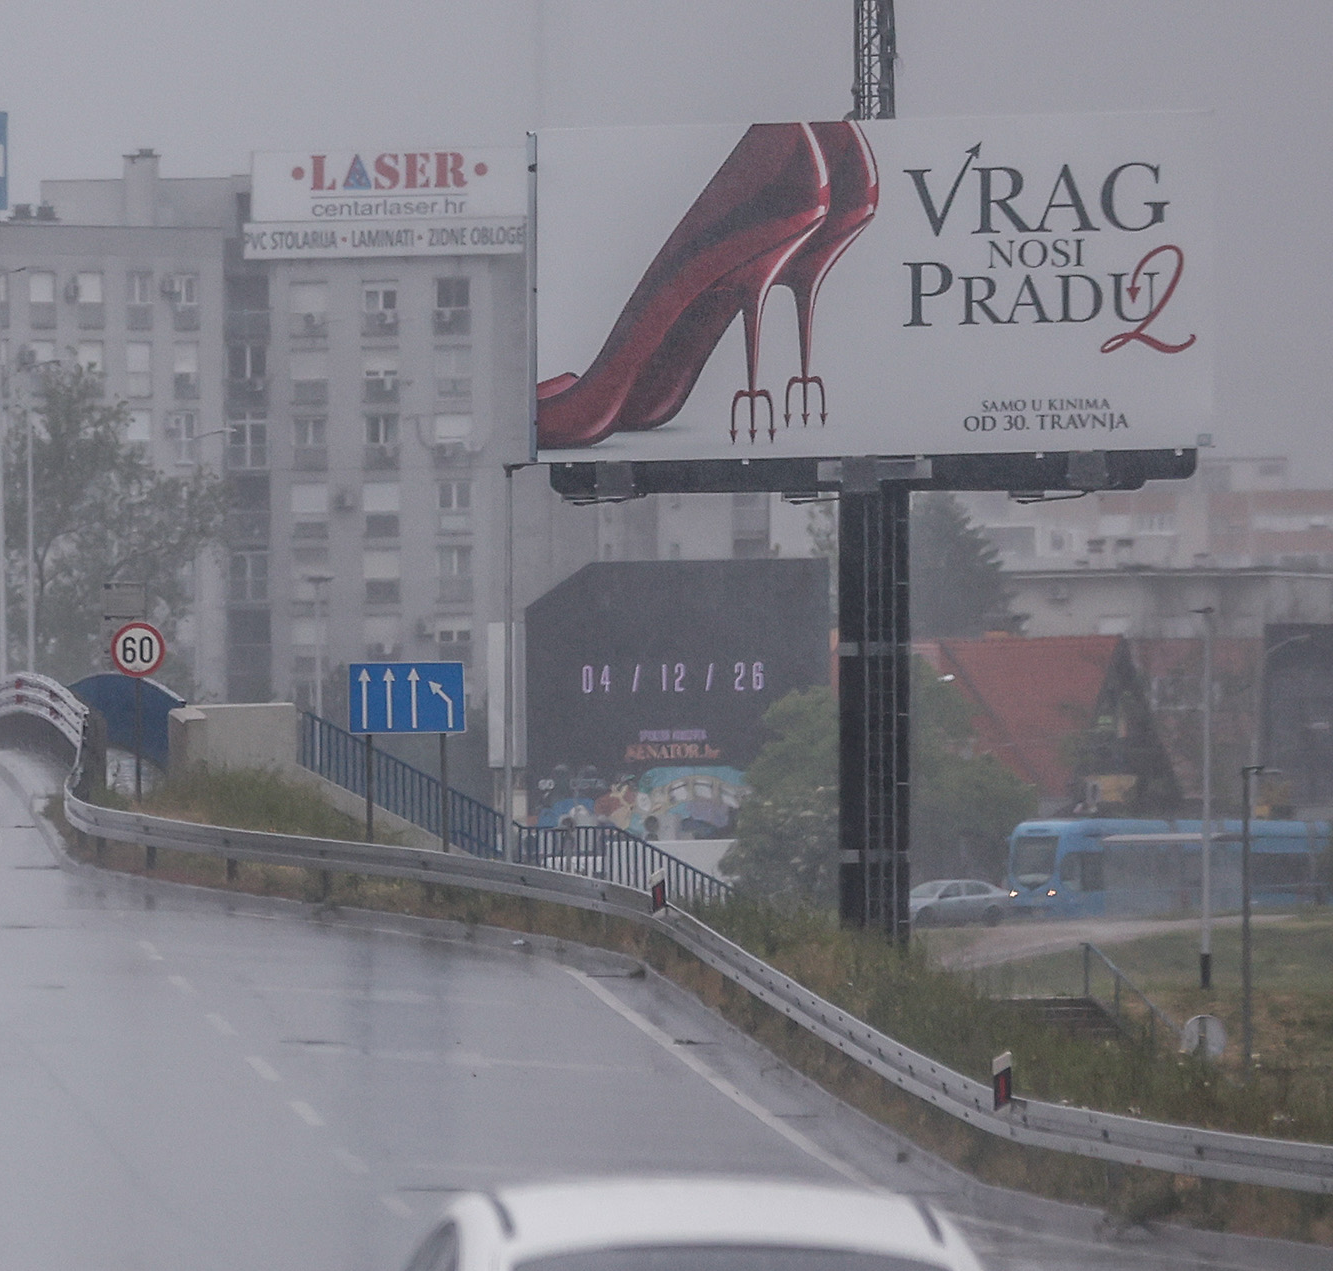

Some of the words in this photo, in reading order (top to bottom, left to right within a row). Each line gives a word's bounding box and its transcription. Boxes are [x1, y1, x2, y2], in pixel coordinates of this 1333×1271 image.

[310, 152, 468, 191] LASER
[903, 141, 1170, 237] VRAG
[244, 231, 268, 250] PVC
[352, 228, 414, 248] LAMINATI
[427, 226, 466, 248] ZIDNE
[988, 238, 1085, 269] NOSI
[903, 262, 1160, 327] PRADU
[1100, 244, 1196, 354] 2
[981, 400, 1027, 412] SAMO
[1031, 400, 1042, 412] U
[1048, 398, 1111, 411] KINIMA
[963, 414, 997, 431] OD
[1003, 415, 1030, 431] 30.
[1036, 412, 1129, 432] TRAVNJA
[121, 635, 154, 665] 60
[582, 664, 612, 694] 04
[661, 662, 687, 692] 12
[734, 661, 765, 691] 26
